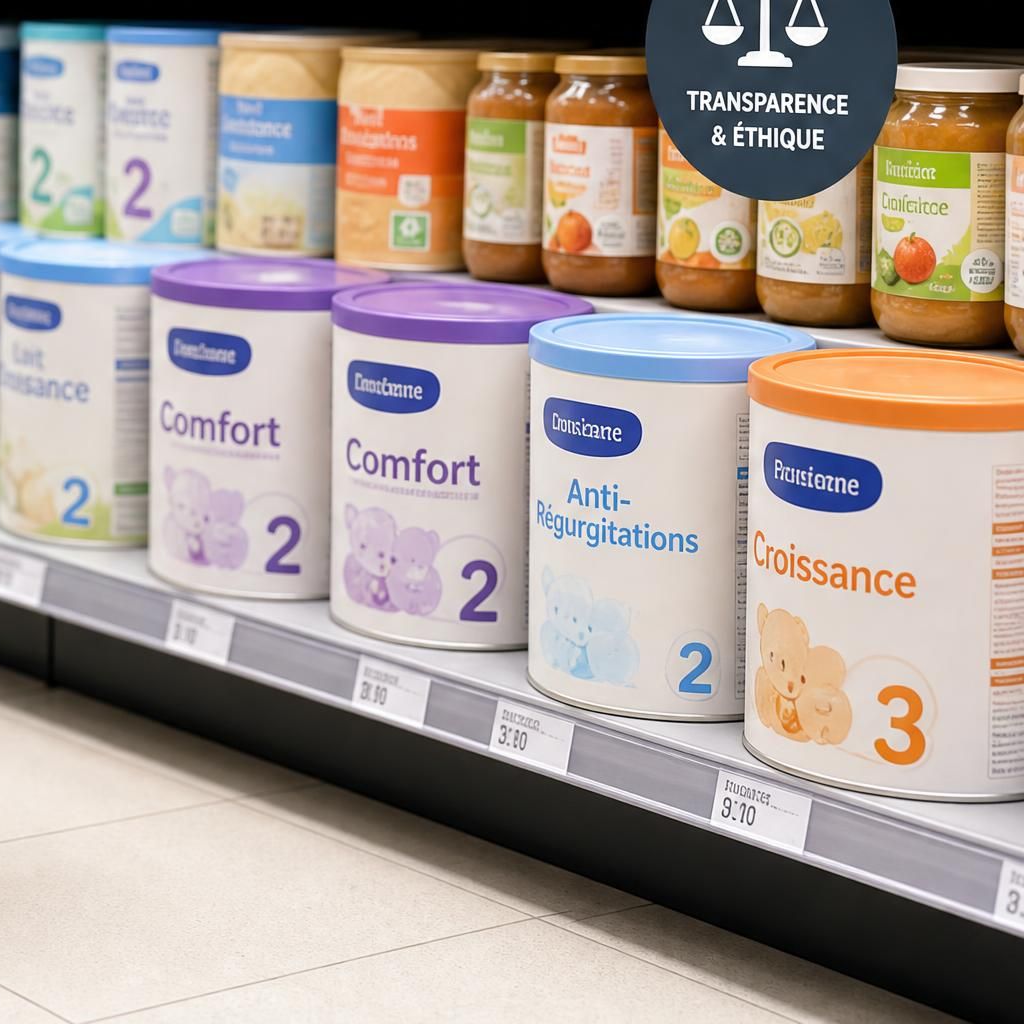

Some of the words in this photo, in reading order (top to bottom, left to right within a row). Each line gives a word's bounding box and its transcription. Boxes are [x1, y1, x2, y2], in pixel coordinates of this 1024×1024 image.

[686, 90, 849, 115] TRANSPARENCE
[711, 125, 727, 147] &
[732, 121, 825, 151] ÉTHIQUE
[30, 146, 54, 205] 2
[122, 156, 155, 221] 2
[160, 399, 281, 448] Comfort
[346, 437, 481, 487] Comfort
[61, 475, 92, 527] 2
[567, 478, 631, 512] Anti-
[264, 514, 302, 575] 2
[536, 499, 699, 554] Régurgitations
[459, 558, 499, 623] 2
[753, 529, 917, 600] Croissance
[678, 641, 713, 695] 2
[873, 684, 927, 767] 3
